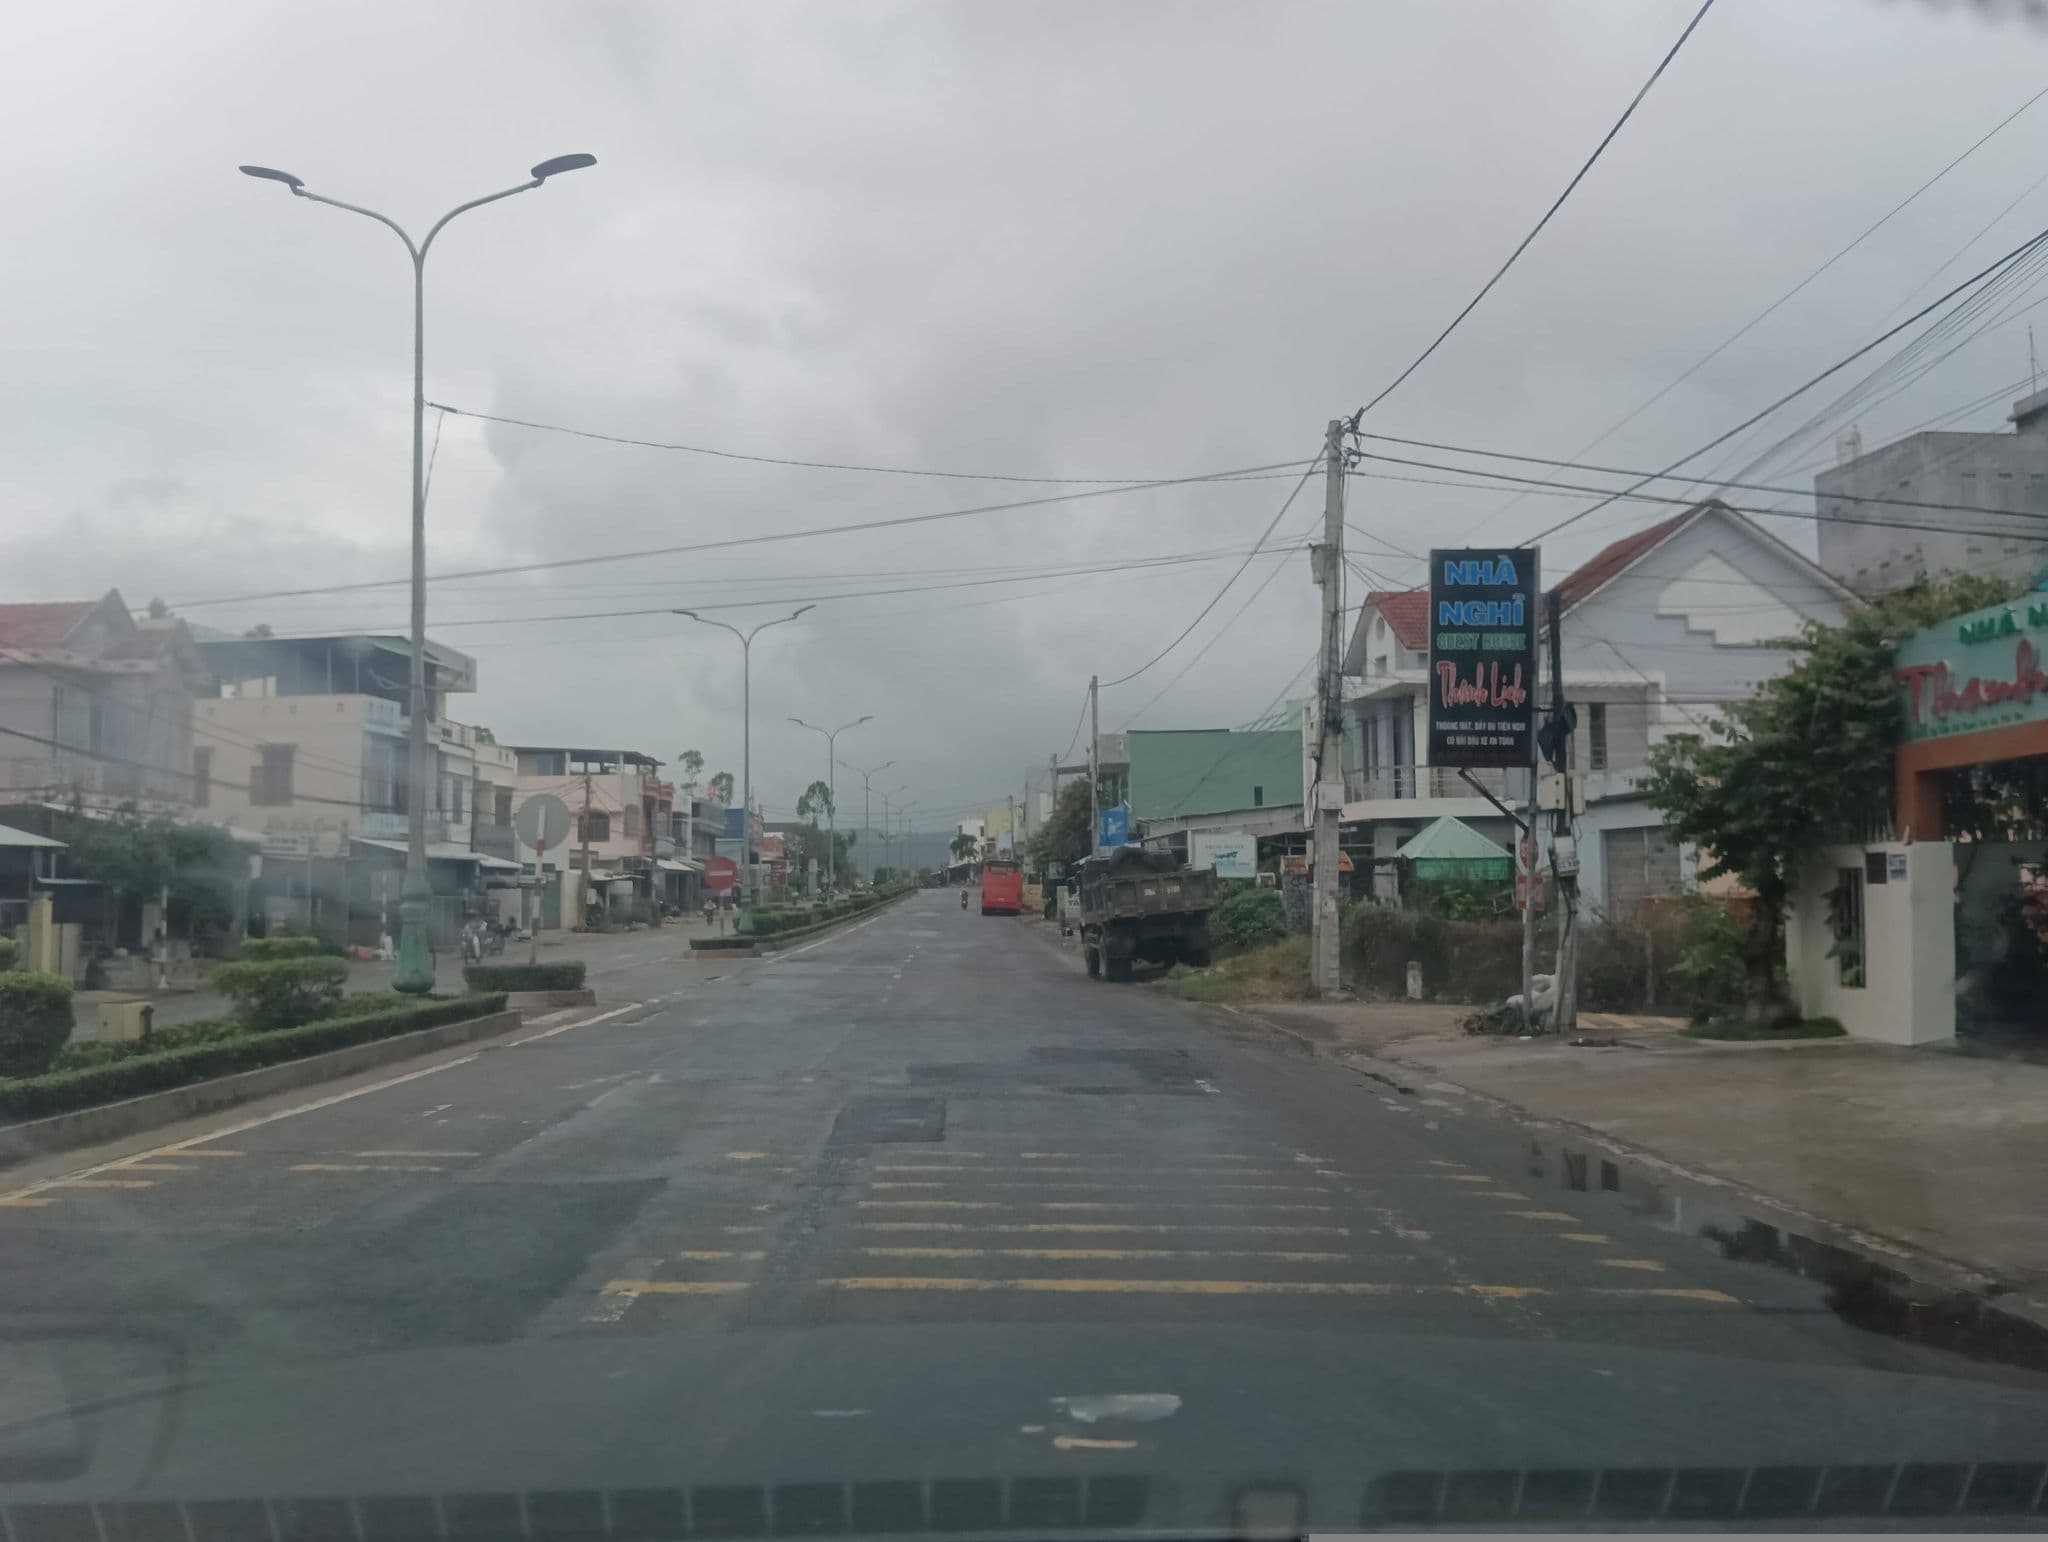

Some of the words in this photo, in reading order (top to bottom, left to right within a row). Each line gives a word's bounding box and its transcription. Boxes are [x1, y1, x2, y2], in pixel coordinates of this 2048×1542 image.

[1444, 555, 1517, 585] NHÀ
[1437, 633, 1479, 650] GUEST
[1960, 606, 2022, 646] NHÀ
[1436, 660, 1488, 709] Thanh
